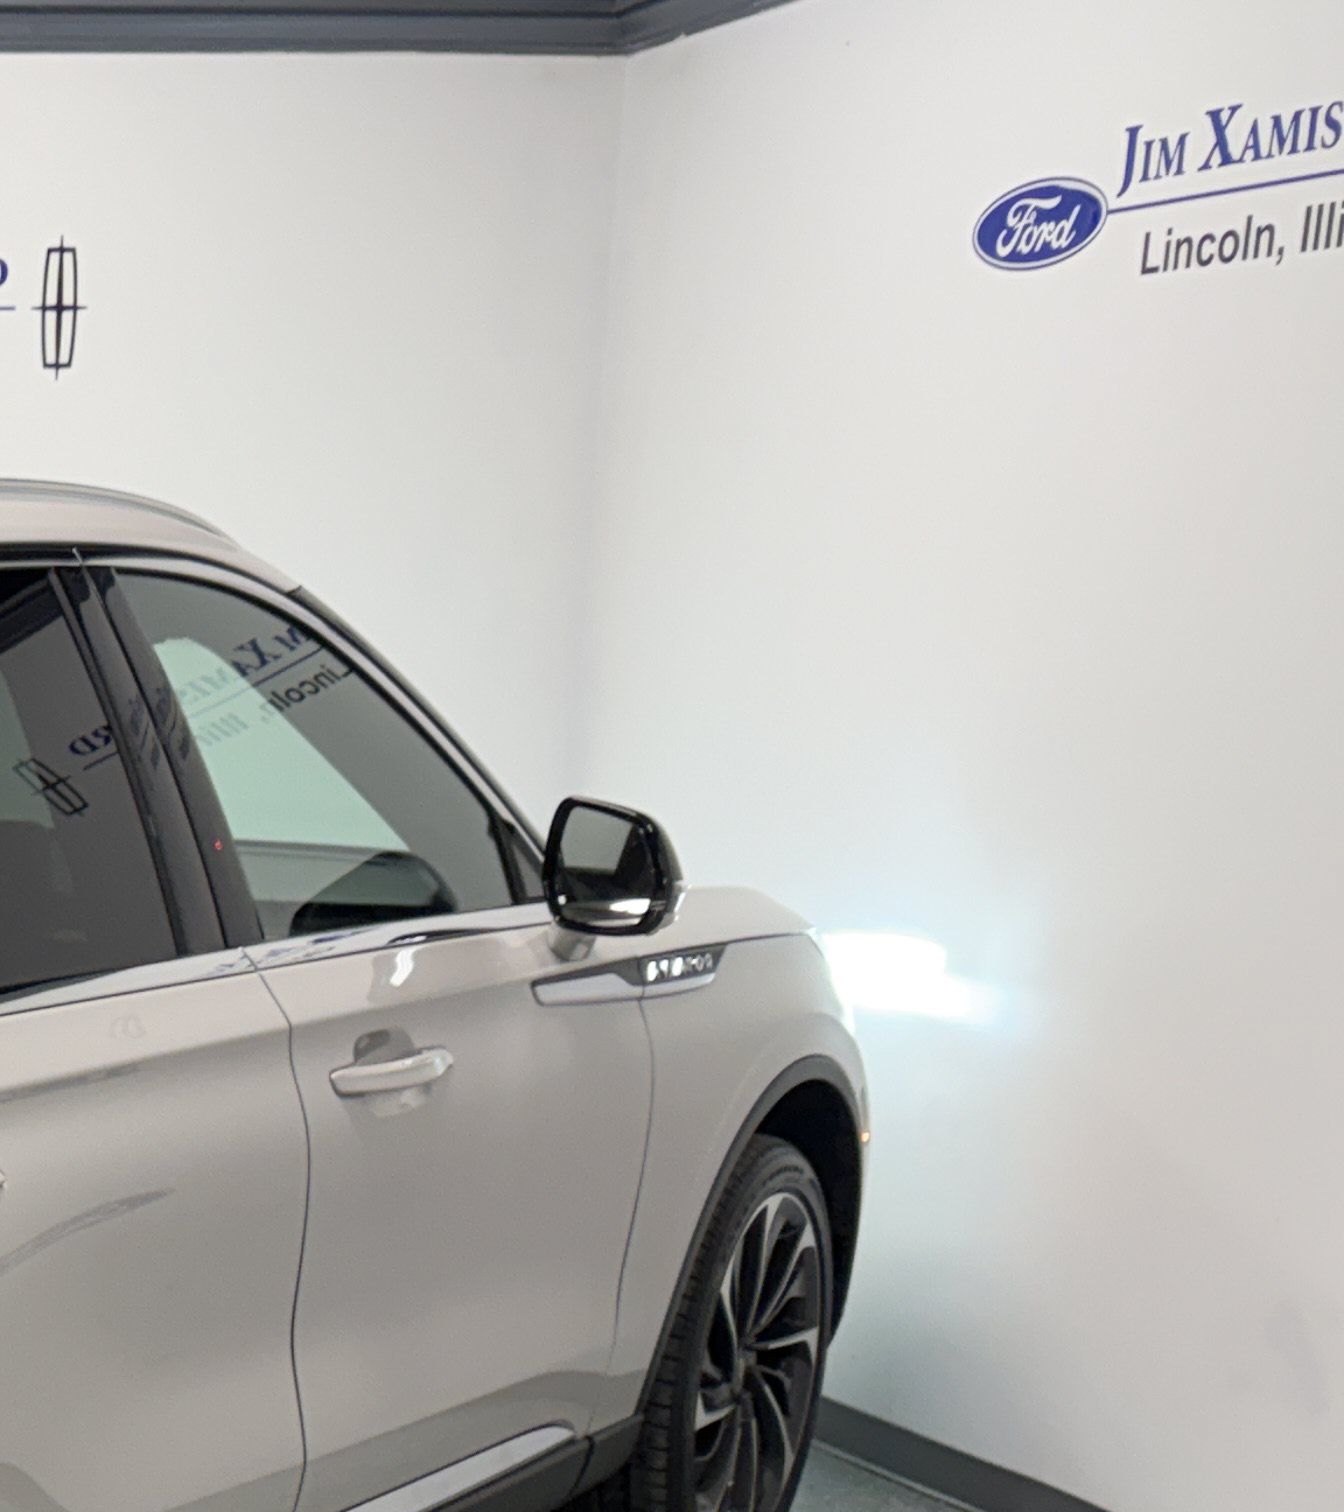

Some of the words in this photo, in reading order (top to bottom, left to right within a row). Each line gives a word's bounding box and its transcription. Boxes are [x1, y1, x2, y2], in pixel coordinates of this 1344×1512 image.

[1116, 124, 1192, 199] JIM
[1197, 101, 1344, 172] XAMIS
[1139, 214, 1285, 276] Lincoln,
[1300, 200, 1344, 253] Illi
